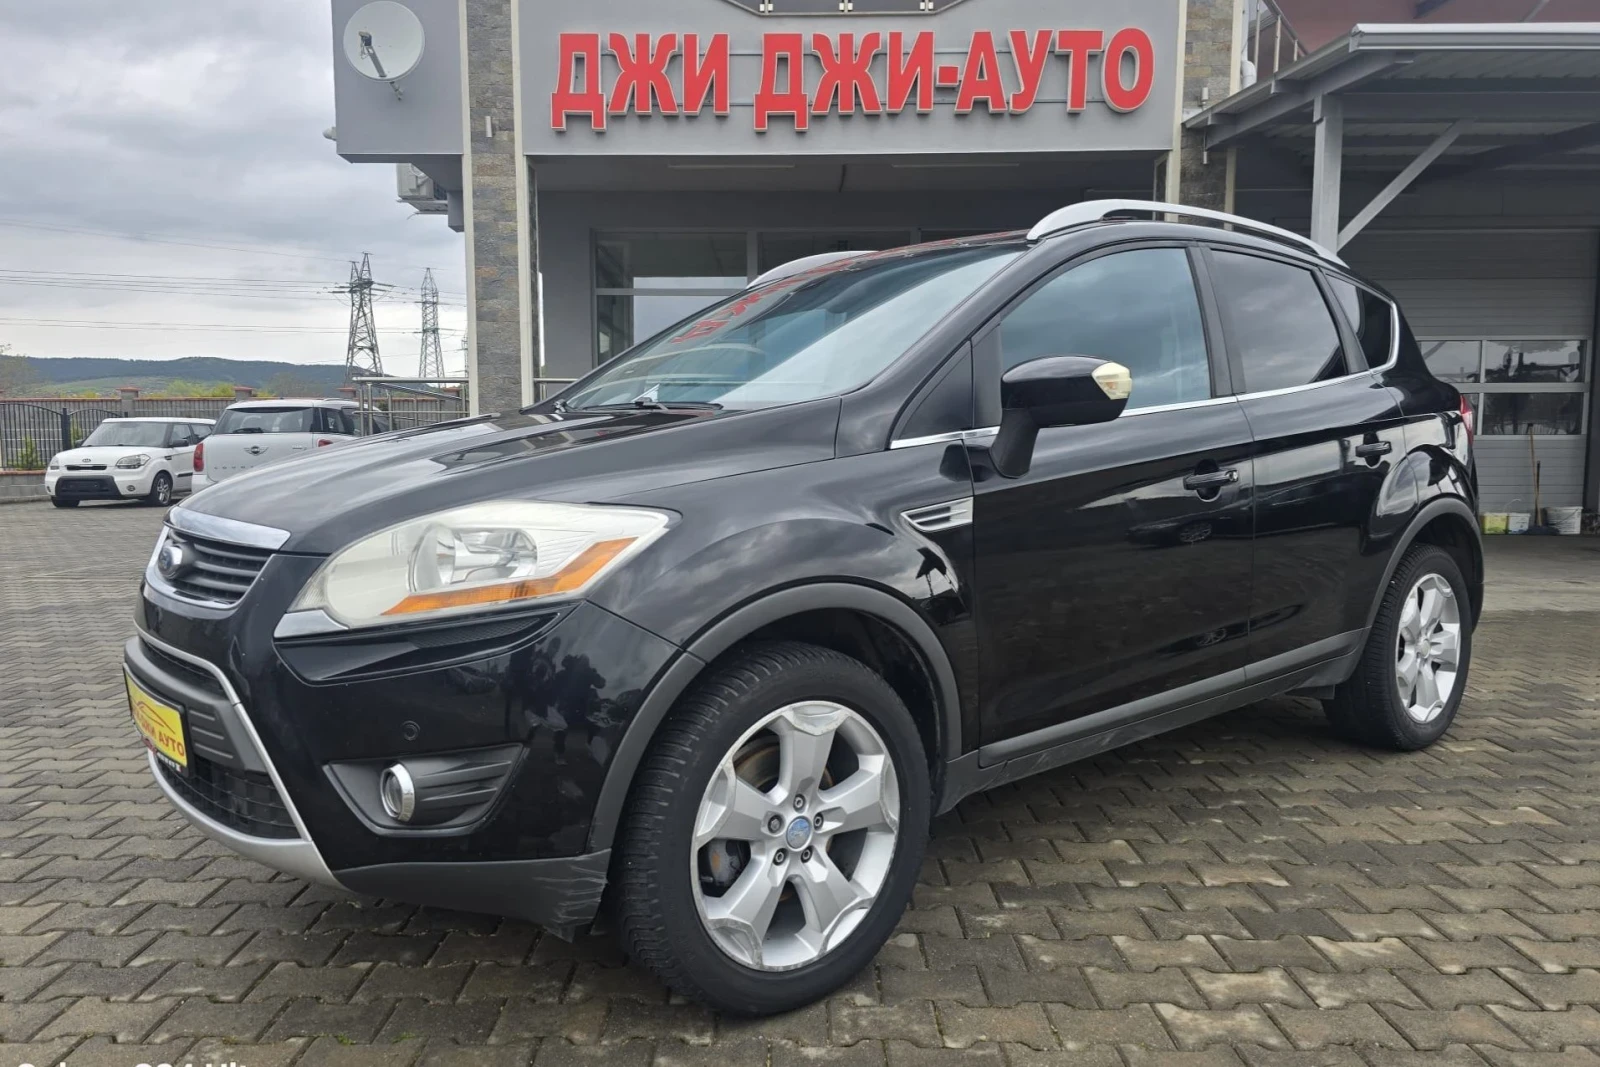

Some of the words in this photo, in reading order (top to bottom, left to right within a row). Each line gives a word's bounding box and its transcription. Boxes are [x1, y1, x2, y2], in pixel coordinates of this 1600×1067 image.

[551, 32, 730, 132] ДЖИ
[753, 27, 1155, 132] ДЖИ-АУТО
[158, 731, 185, 757] АУТО
